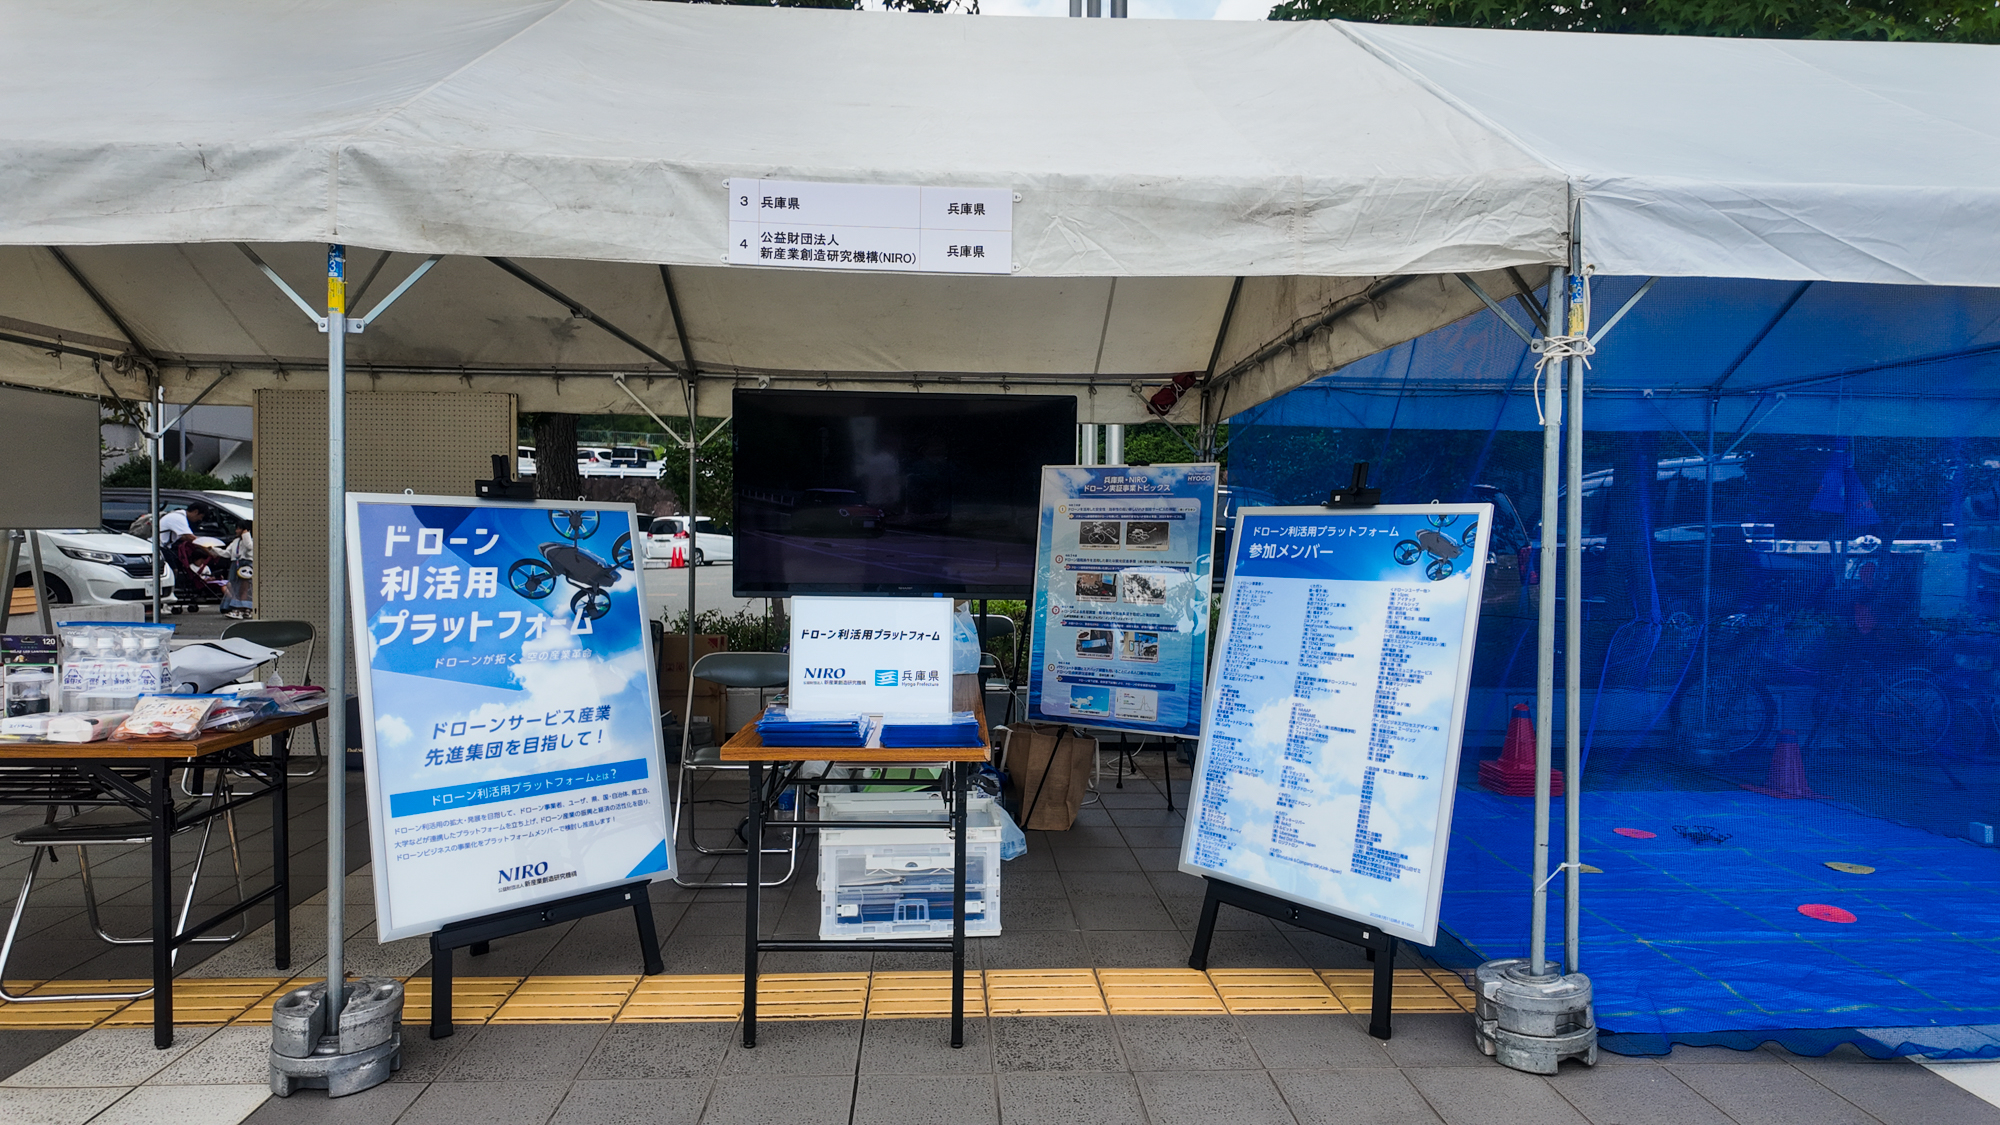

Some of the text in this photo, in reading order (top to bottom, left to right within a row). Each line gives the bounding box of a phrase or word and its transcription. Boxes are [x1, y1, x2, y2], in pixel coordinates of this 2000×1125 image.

[740, 196, 986, 216] 3 兵庫県 兵庫県
[760, 231, 840, 246] 公益財団法人
[740, 239, 986, 264] 4 新産業創造研究機構(NIRO) 兵庫県
[1084, 484, 1171, 492] ドローン実証事業トピックス
[384, 526, 500, 557] ドローン
[1253, 526, 1400, 537] ドローン利活用プラットフォーム
[1249, 542, 1334, 559] 参加メンバー
[380, 566, 498, 602] 利活用
[378, 608, 593, 646] プラットフォーム
[801, 628, 940, 641] ドローン利活用プラットフォーム
[804, 668, 940, 682] NIRO 兵庫県
[432, 704, 612, 740] ドローンサービス産業
[424, 729, 604, 768] 先進集団を目指して！
[431, 768, 618, 806] ドローン利活用プラットフォームとは？
[498, 862, 548, 884] NIRO
